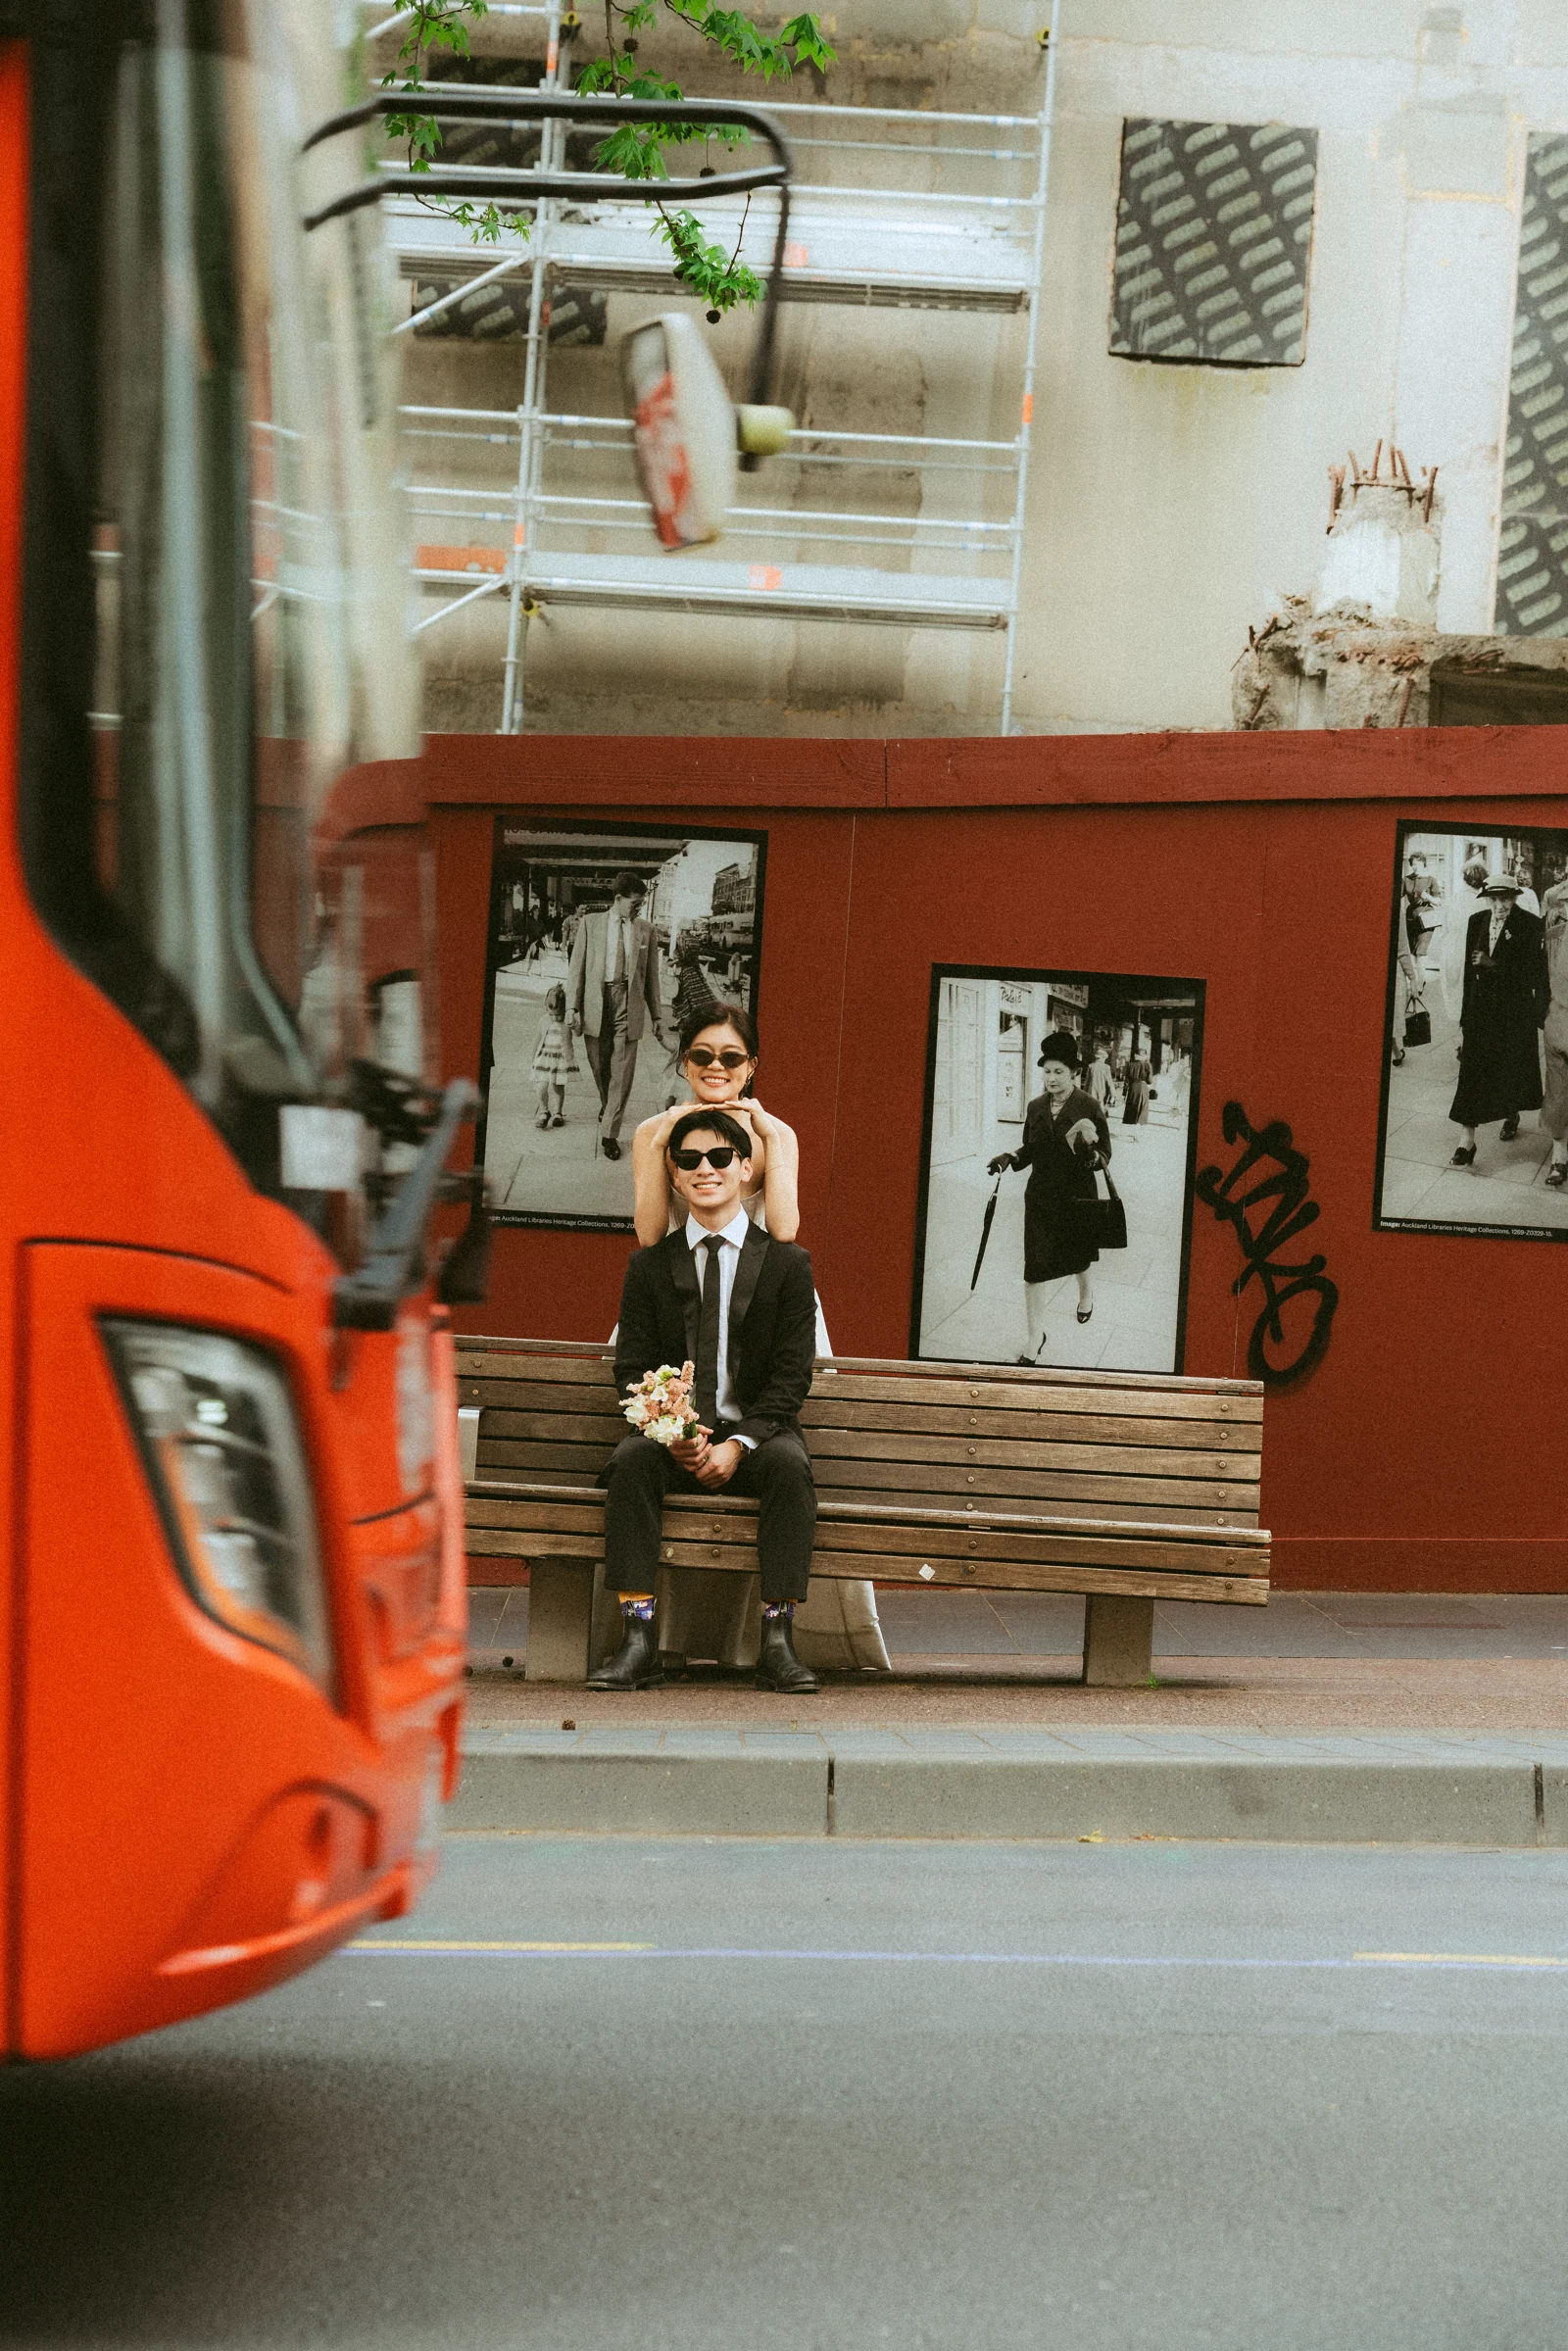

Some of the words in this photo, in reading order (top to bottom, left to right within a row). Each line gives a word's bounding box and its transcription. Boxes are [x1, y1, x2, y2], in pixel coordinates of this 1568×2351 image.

[528, 1216, 553, 1225] Libraries
[553, 1218, 576, 1227] Heritage
[1380, 1220, 1400, 1229] Image:
[1400, 1221, 1428, 1230] Auckland
[1428, 1223, 1452, 1232] Libraries
[1453, 1225, 1477, 1234] Heritage
